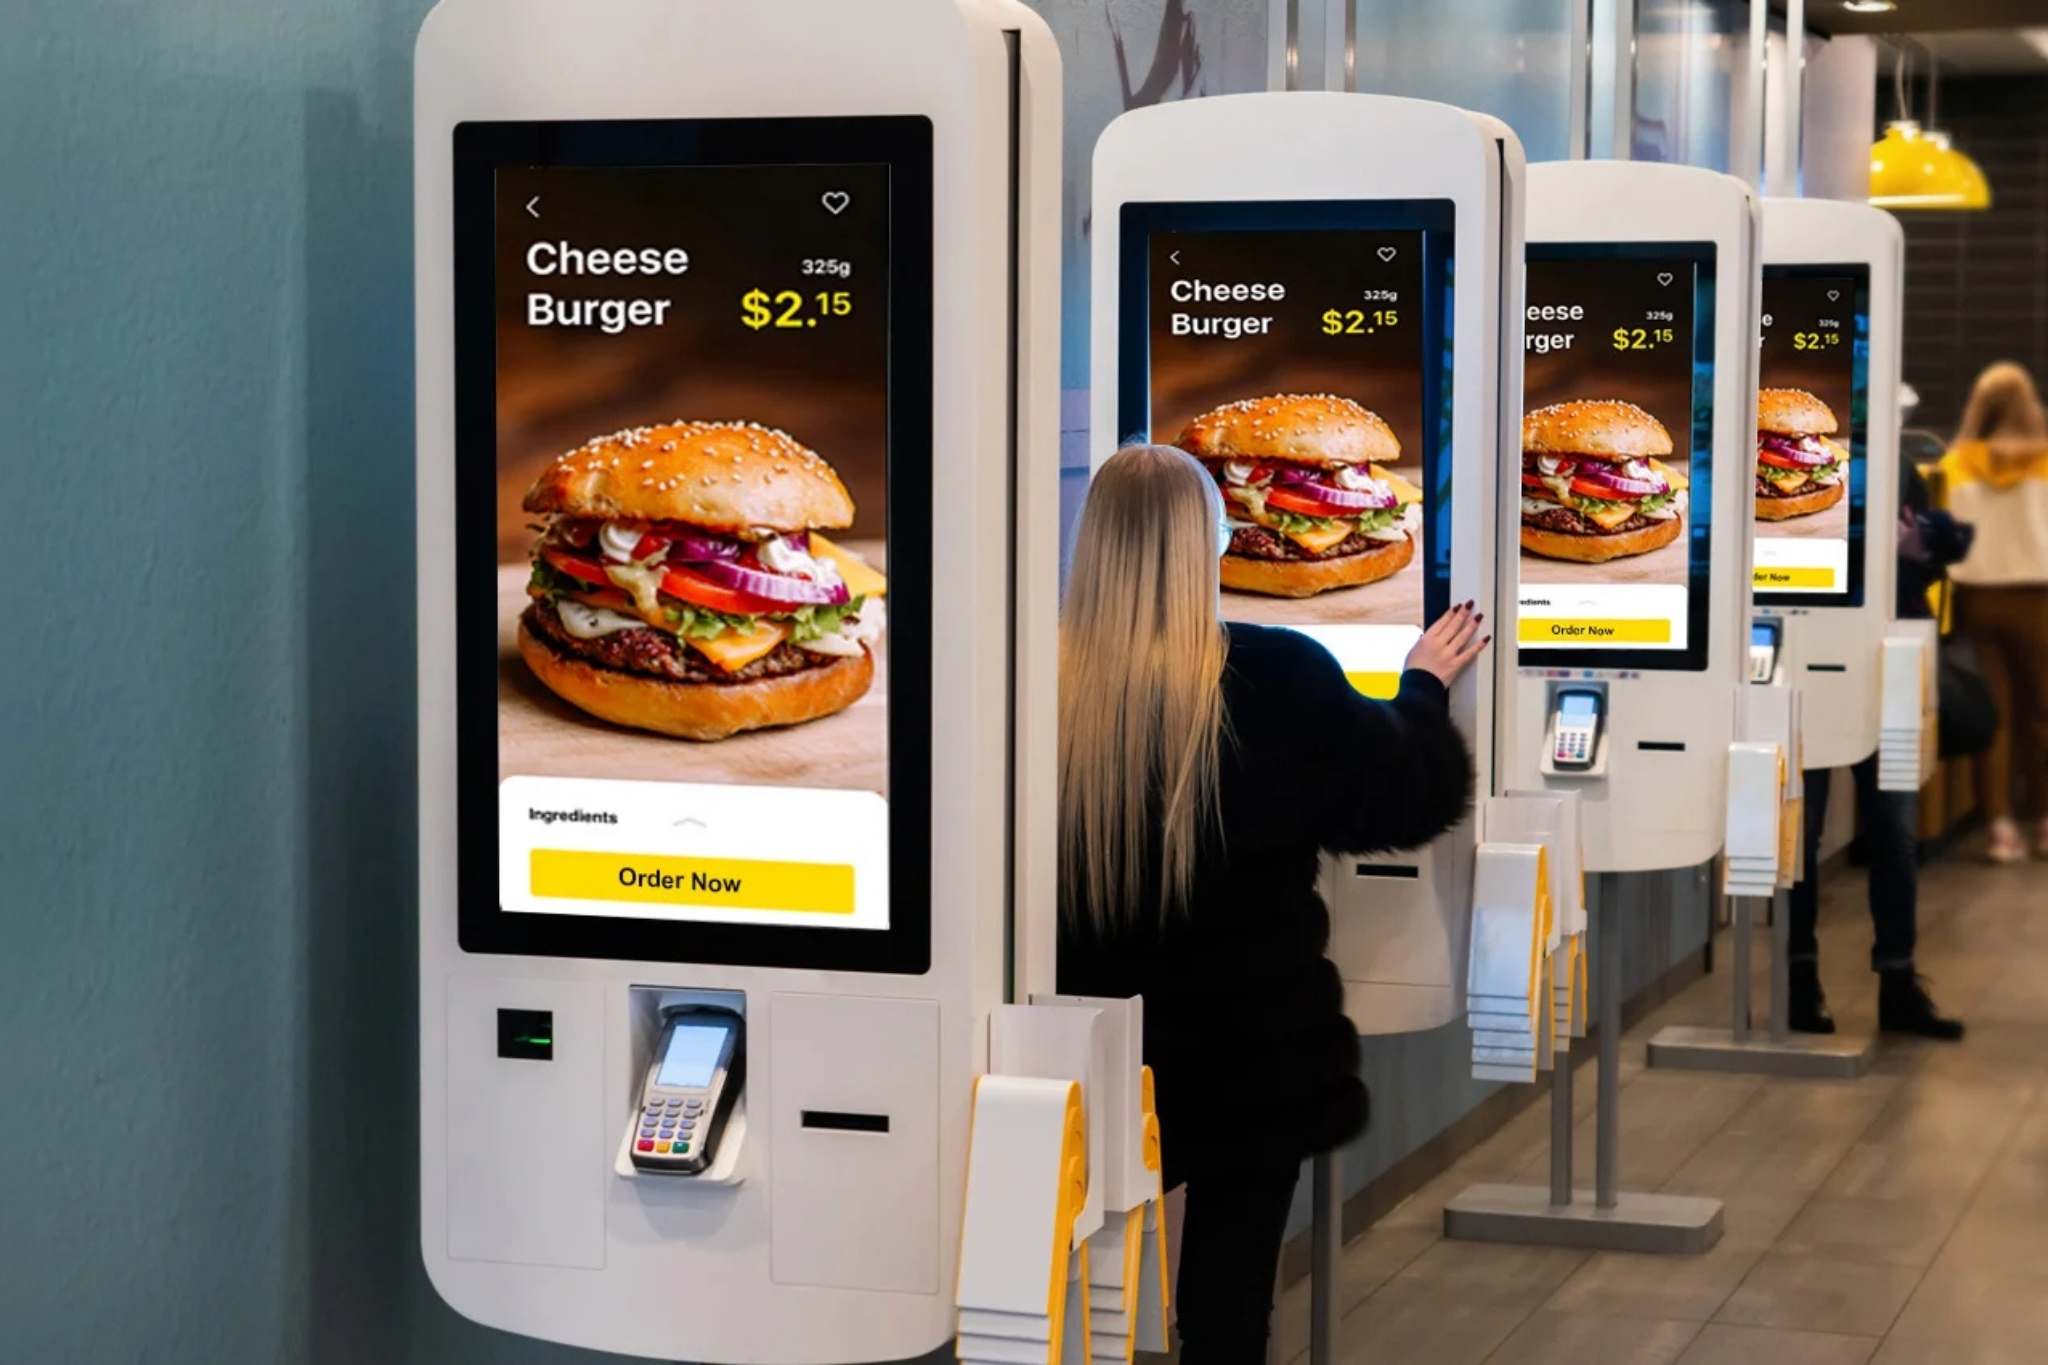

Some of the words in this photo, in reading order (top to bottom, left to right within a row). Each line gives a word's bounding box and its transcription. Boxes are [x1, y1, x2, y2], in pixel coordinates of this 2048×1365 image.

[526, 239, 689, 277] Cheese
[802, 259, 851, 279] 325g
[1170, 279, 1286, 302] Cheese
[1363, 290, 1398, 302] 325g
[527, 293, 671, 334] Burger
[741, 287, 852, 331] $2.15
[1526, 304, 1584, 321] eese
[1646, 311, 1674, 322] 325g
[1171, 313, 1273, 340] Burger
[1321, 308, 1399, 336] $2.15
[1525, 333, 1575, 354] rger
[1613, 326, 1674, 351] $2.15
[1793, 331, 1840, 351] $2.15
[1769, 572, 1791, 583] Now
[1518, 598, 1551, 606] redients
[1551, 624, 1586, 636] Order
[1588, 625, 1615, 637] Now
[528, 807, 619, 826] Ingredients
[618, 866, 685, 891] Order
[690, 871, 743, 894] Now
